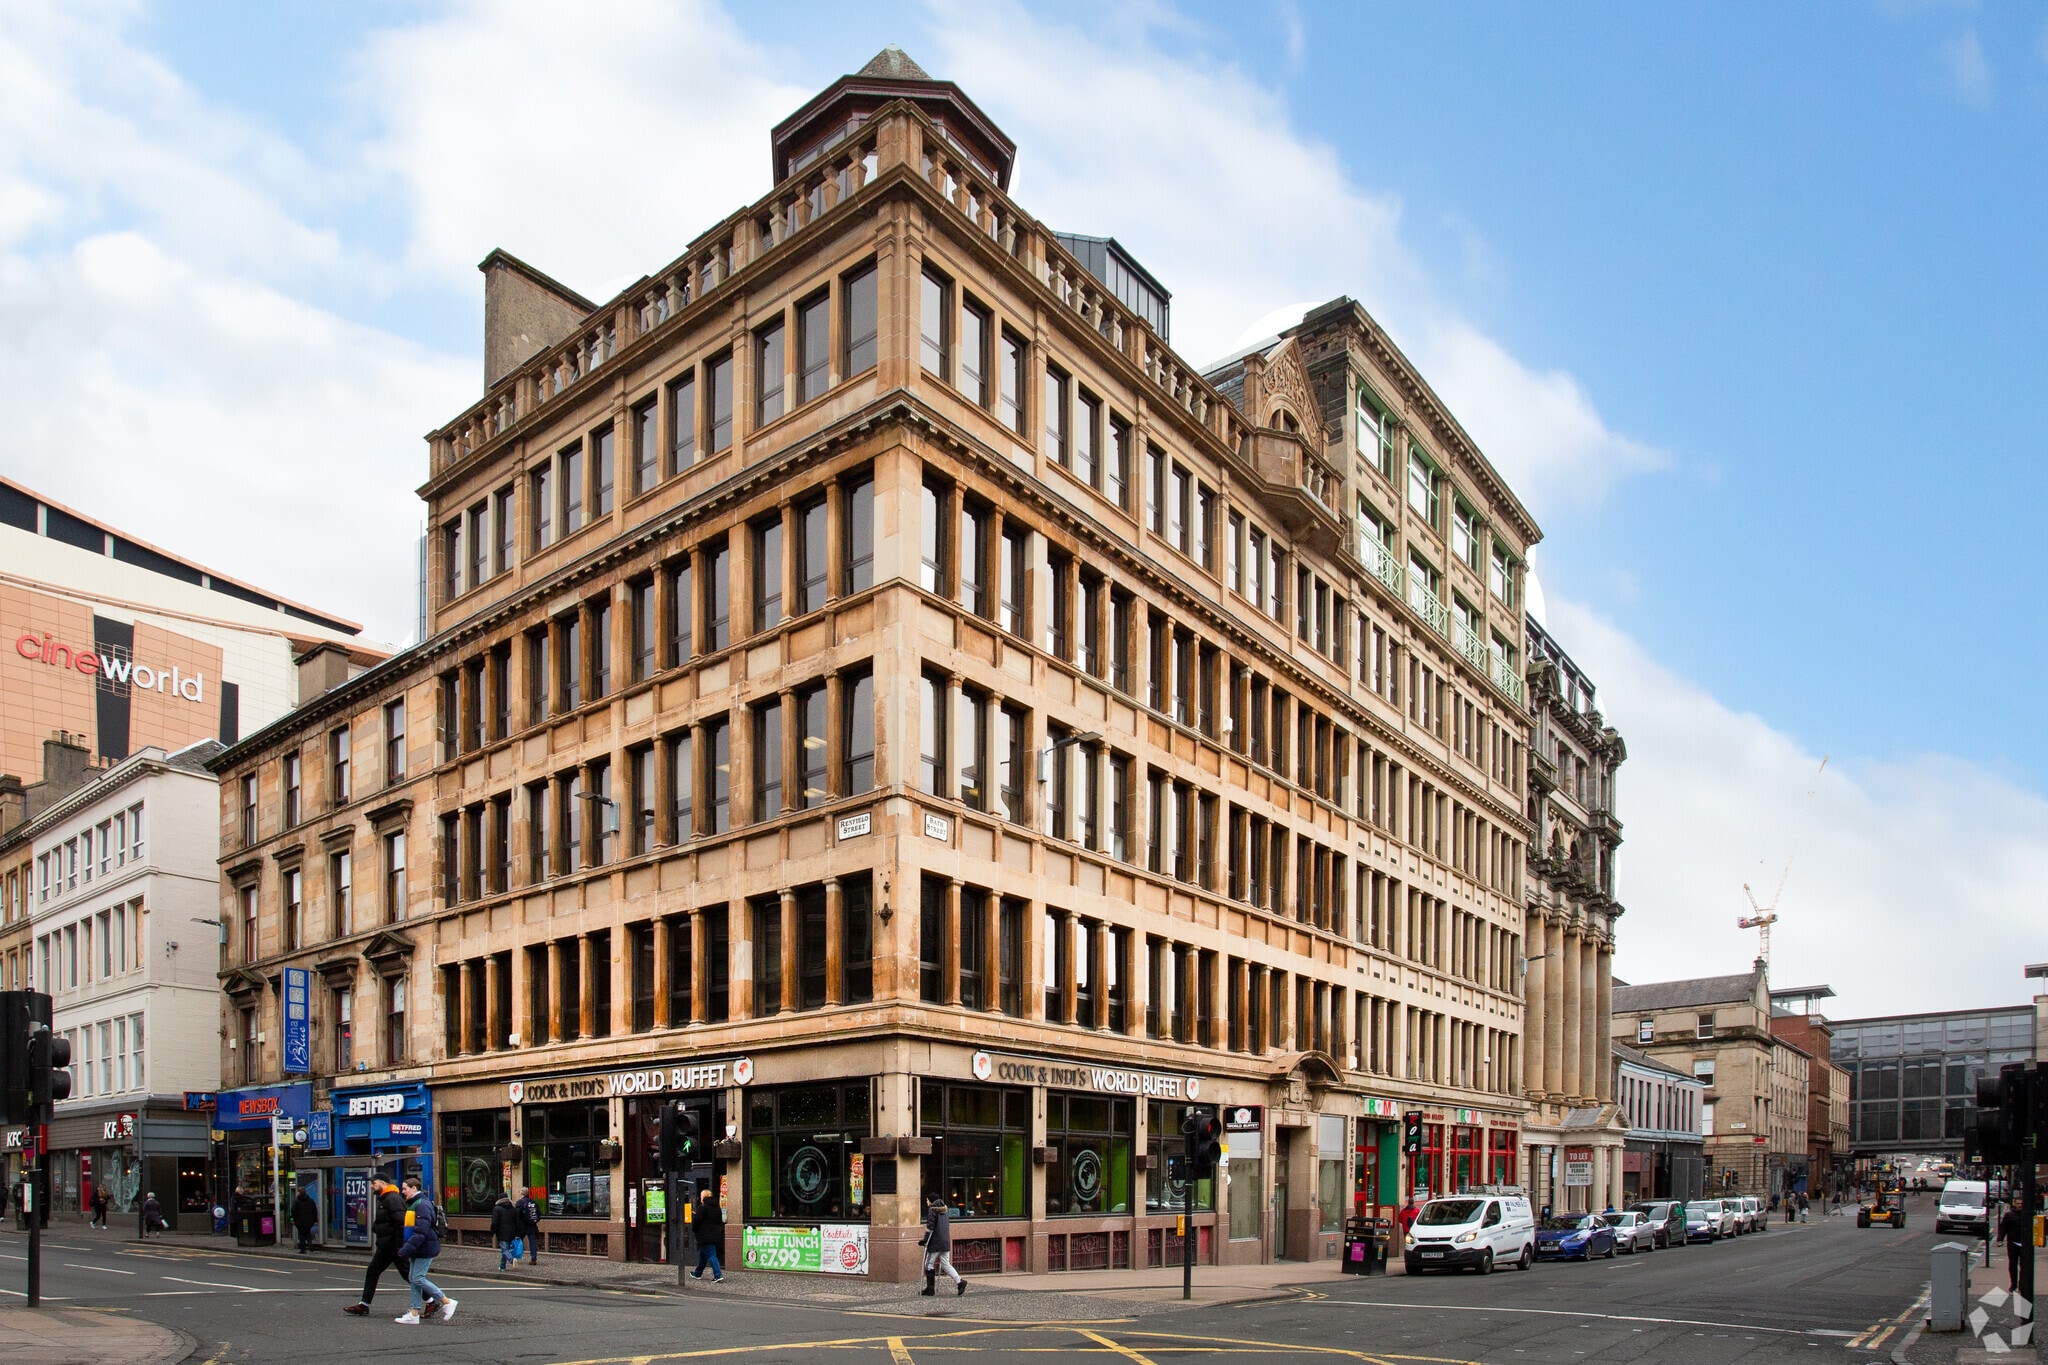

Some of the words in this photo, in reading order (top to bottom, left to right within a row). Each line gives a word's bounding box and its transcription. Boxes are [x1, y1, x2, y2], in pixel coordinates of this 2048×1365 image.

[16, 633, 202, 703] cineworld
[840, 816, 869, 828] RENFIELD
[843, 823, 866, 834] STREET
[927, 824, 946, 836] STREET
[527, 1084, 557, 1101] COOK
[558, 1084, 568, 1098] &
[570, 1078, 605, 1097] INDI'S
[607, 1070, 666, 1095] WORLD
[671, 1064, 726, 1090] BUFFET
[999, 1061, 1035, 1082] COOK
[1038, 1066, 1047, 1083] &
[1051, 1067, 1086, 1086] INDI'S
[1090, 1069, 1140, 1093] WORLD
[1142, 1076, 1182, 1097] BUFFET
[187, 1094, 200, 1109] 24
[239, 1097, 279, 1114] NEWSBOX
[349, 1094, 404, 1116] BETFRED
[1366, 1098, 1398, 1117] ROMA
[1456, 1109, 1483, 1124] ROMA
[103, 1121, 123, 1139] KF
[6, 1131, 23, 1147] KFC
[1569, 1152, 1577, 1160] TO
[1578, 1152, 1588, 1160] LET
[346, 1180, 367, 1195] £175
[528, 1186, 547, 1199] OPEN
[823, 1228, 853, 1239] Cocktails
[747, 1235, 780, 1248] BUFFET
[783, 1236, 819, 1249] LUNCH
[760, 1248, 801, 1268] £7.99
